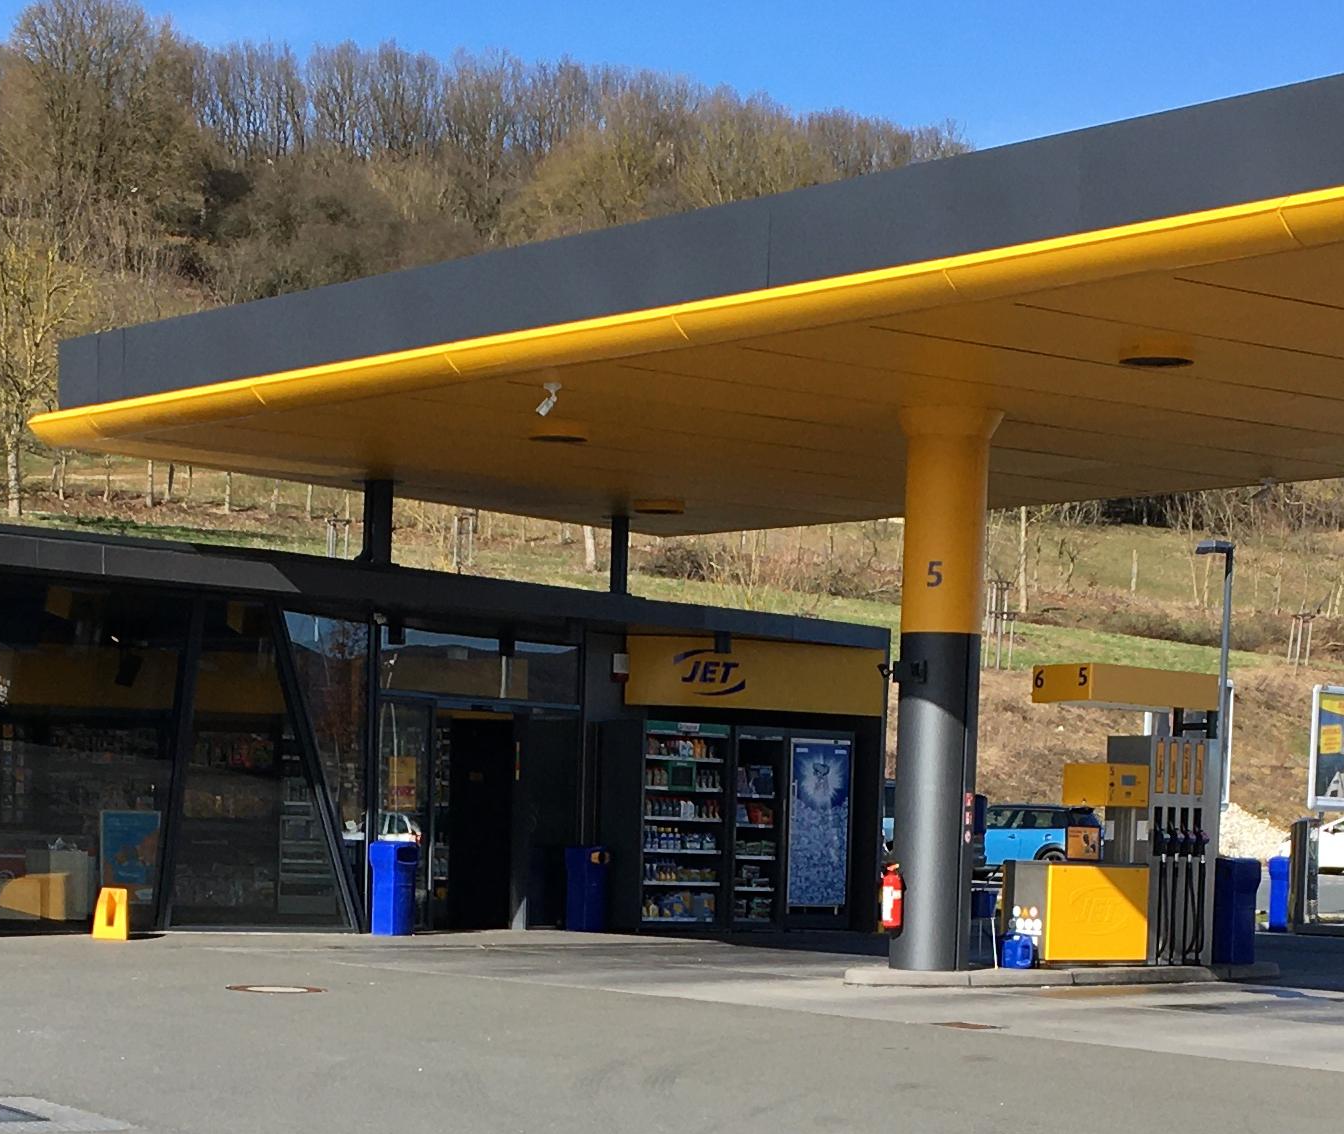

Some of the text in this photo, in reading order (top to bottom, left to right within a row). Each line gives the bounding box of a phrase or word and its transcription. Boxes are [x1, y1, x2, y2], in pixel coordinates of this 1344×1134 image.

[927, 560, 944, 588] 5
[681, 661, 740, 683] JET
[1034, 666, 1088, 689] 6 5
